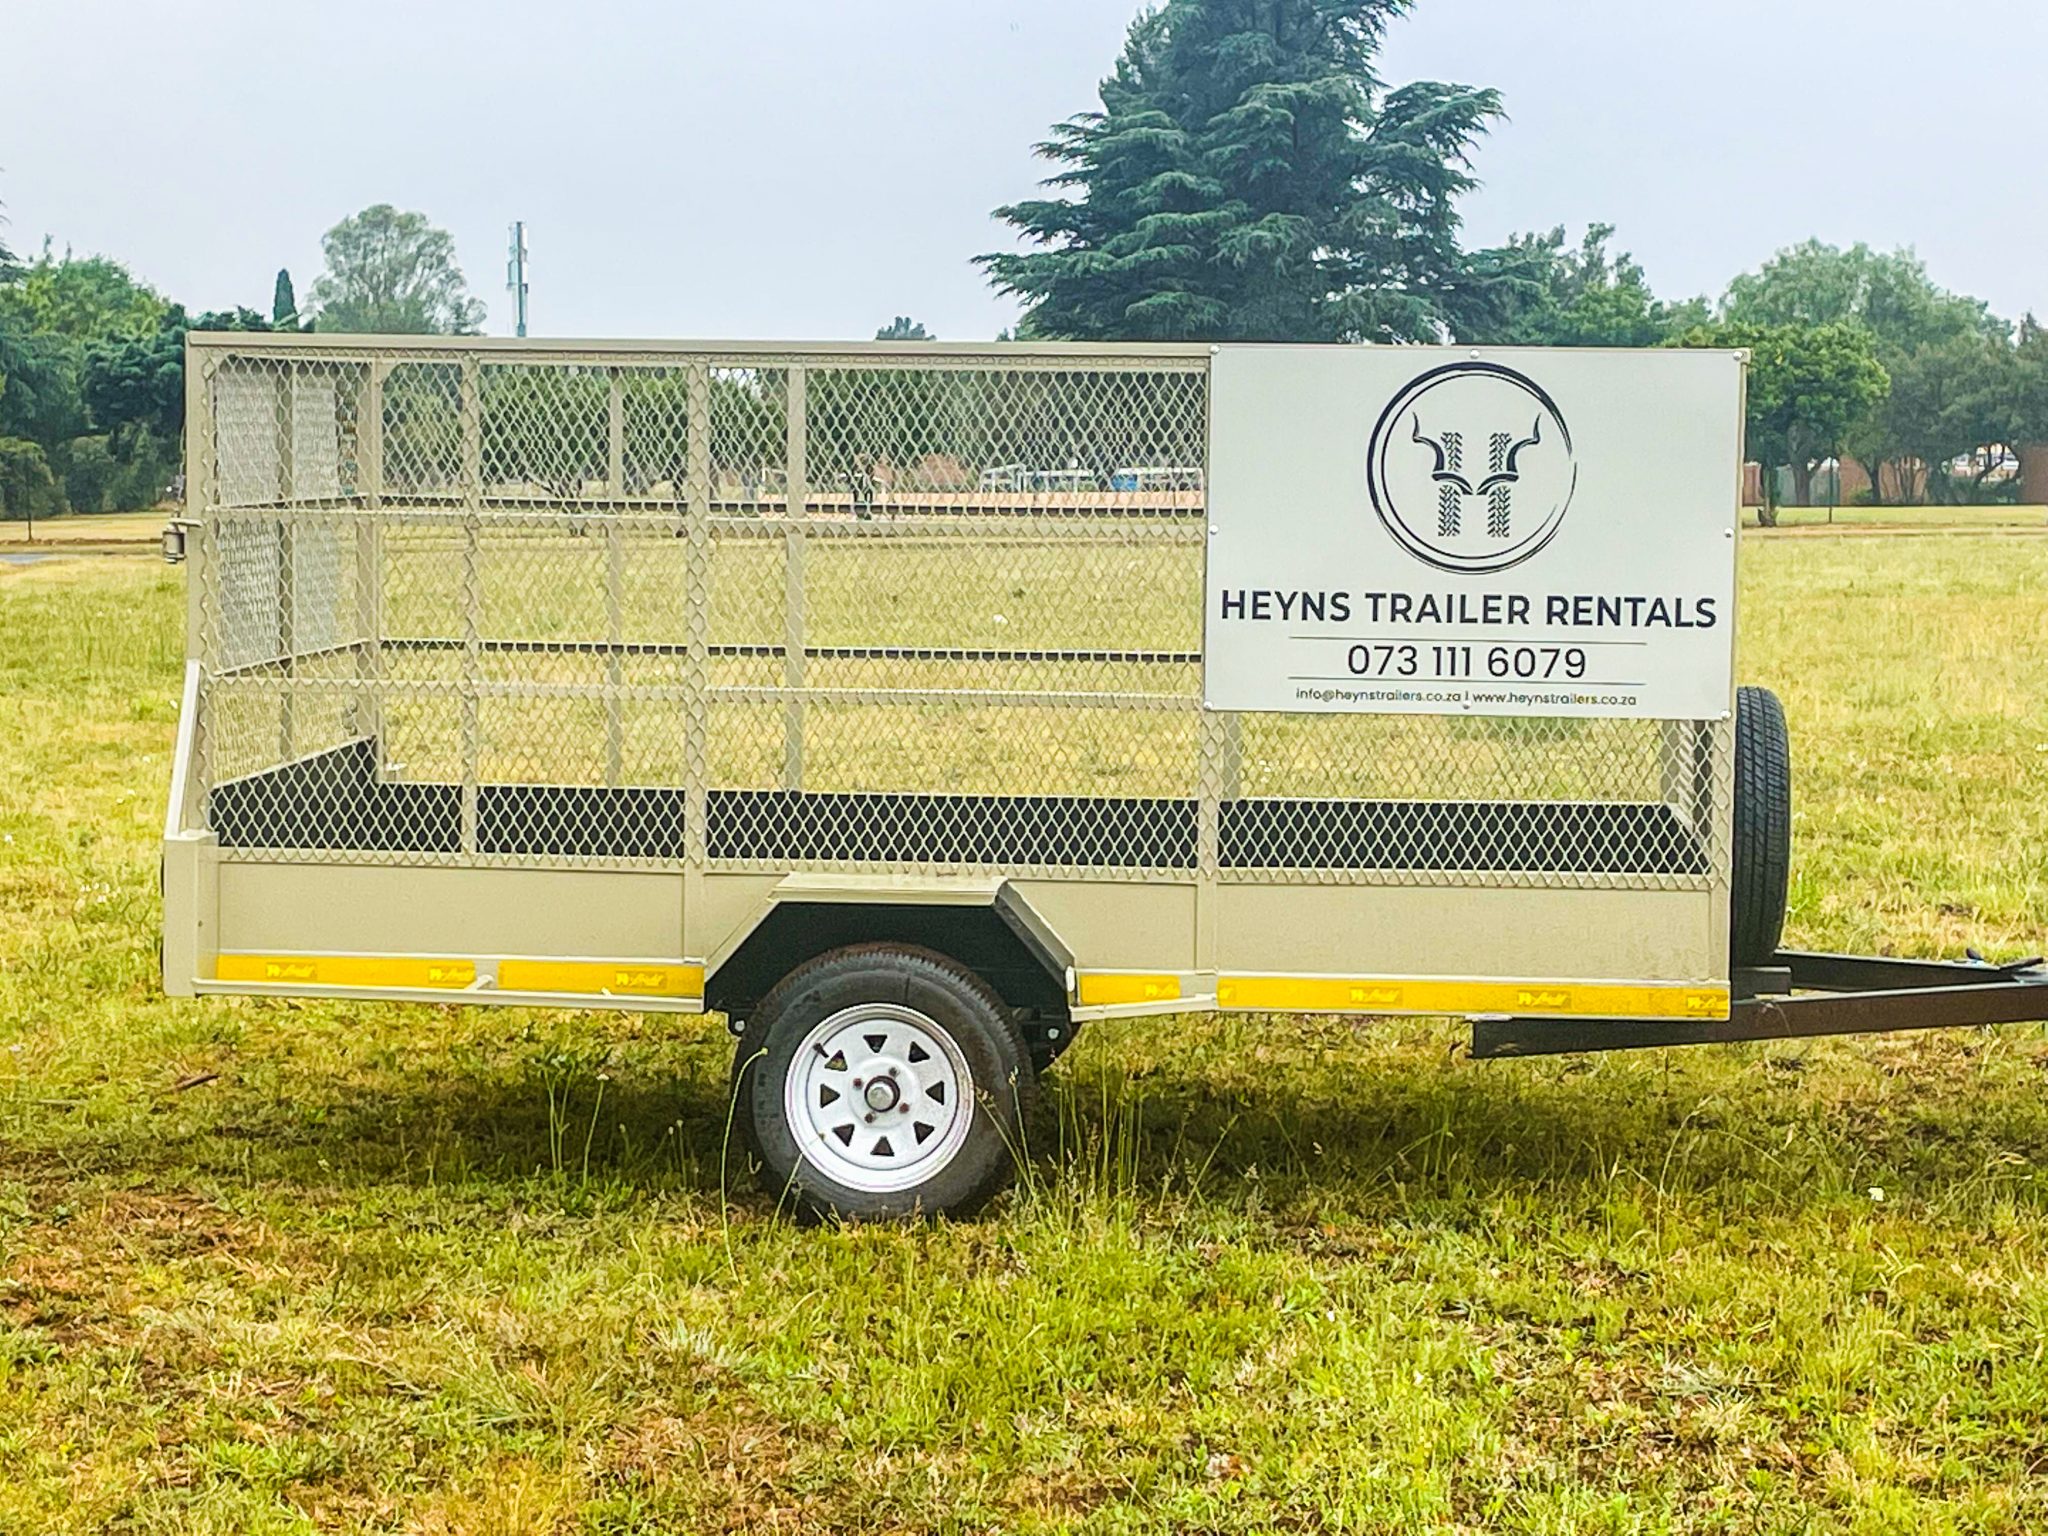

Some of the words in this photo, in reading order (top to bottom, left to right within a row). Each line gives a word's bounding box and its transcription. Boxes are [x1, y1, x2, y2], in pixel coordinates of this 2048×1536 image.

[1221, 589, 1351, 622] HEYNS
[1365, 592, 1530, 625] TRAILER
[1546, 595, 1717, 628] RENTALS
[1348, 644, 1418, 677] 073
[1432, 646, 1471, 678] 111
[1487, 647, 1587, 680] 6079
[1296, 687, 1462, 703] info@heynstrailers.co.za
[1472, 692, 1637, 707] www.heynstrailers.co.za
